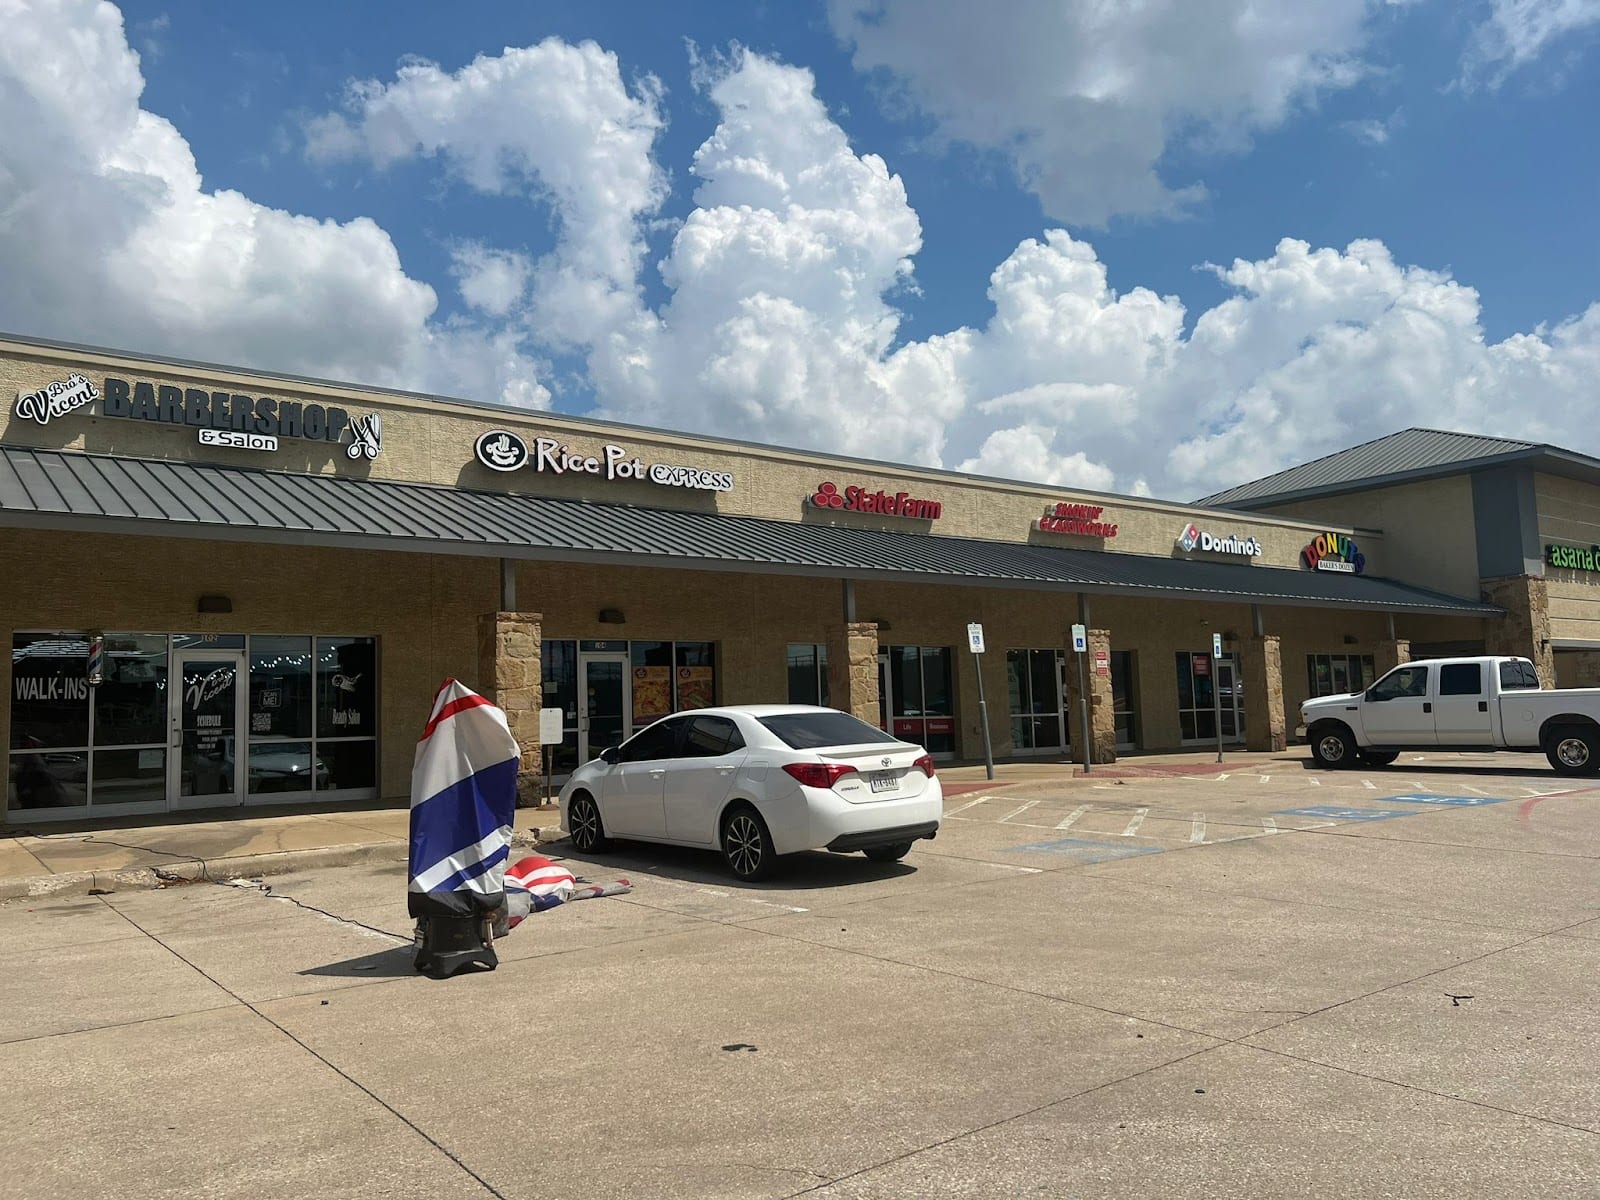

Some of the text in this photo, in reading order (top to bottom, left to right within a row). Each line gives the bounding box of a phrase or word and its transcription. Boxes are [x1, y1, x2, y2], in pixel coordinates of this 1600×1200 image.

[48, 372, 87, 398] Bro's
[17, 381, 99, 423] Vicent
[104, 378, 348, 442] BARBERSHOP
[201, 430, 276, 450] & Salon
[534, 437, 600, 474] Rice
[603, 444, 647, 481] Pot
[1200, 531, 1262, 557] Domino's
[15, 677, 88, 700] WALK-INS
